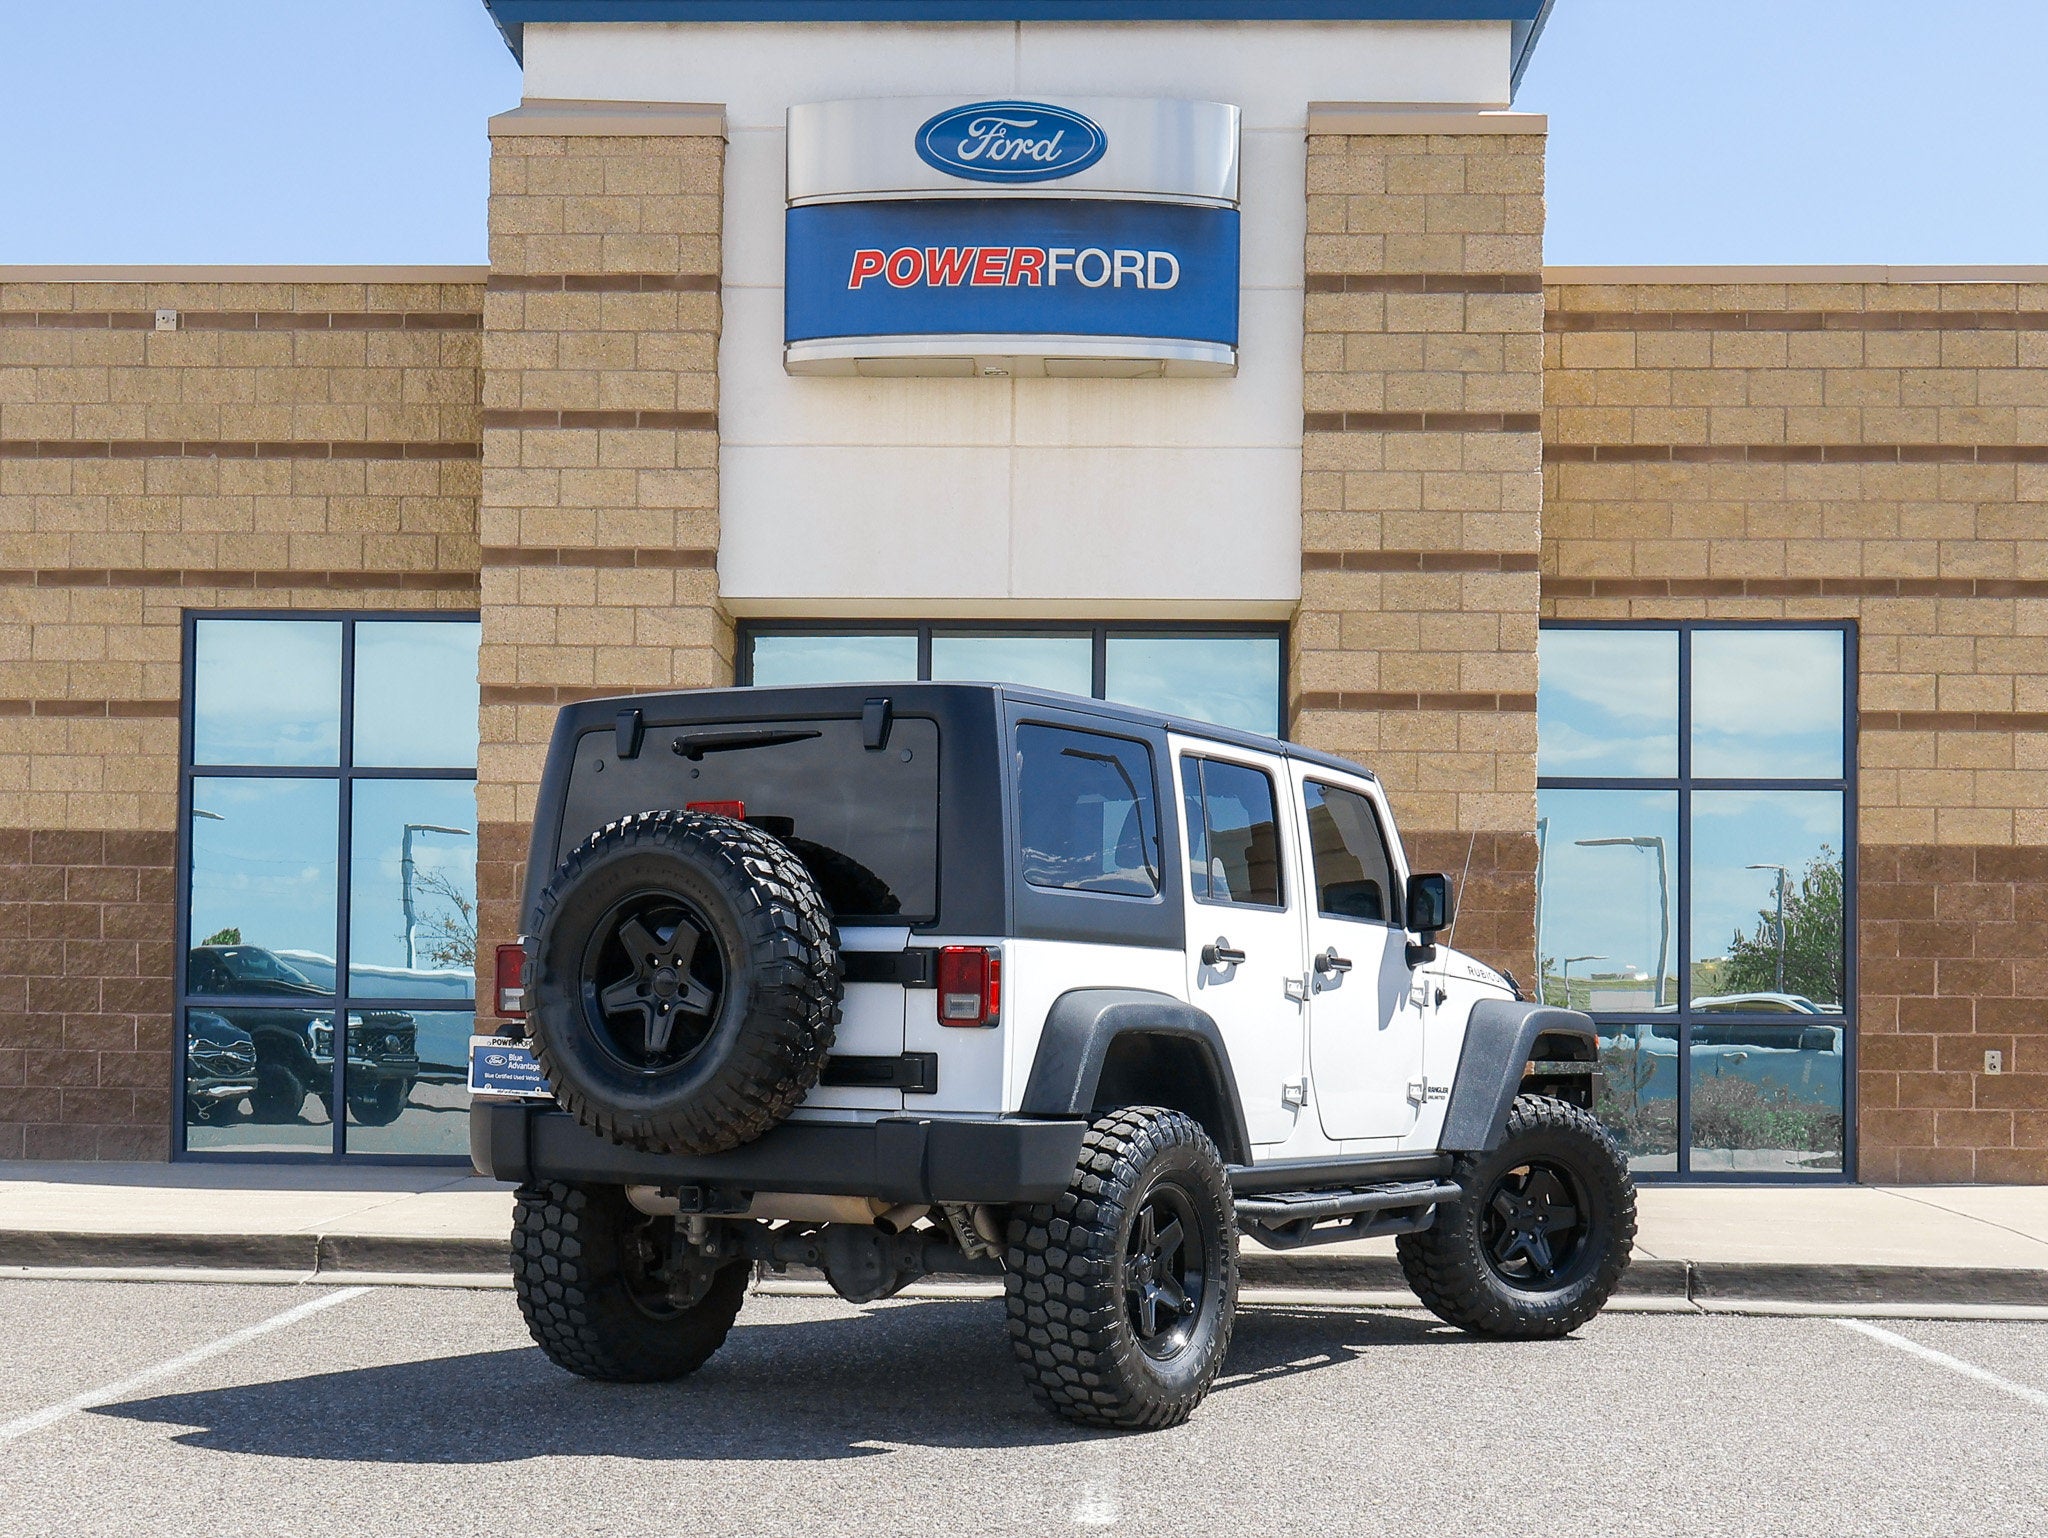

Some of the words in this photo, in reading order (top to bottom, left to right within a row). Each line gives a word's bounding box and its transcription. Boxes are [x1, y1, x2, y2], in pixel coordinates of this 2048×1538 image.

[957, 117, 1065, 163] Ford
[508, 1053, 524, 1061] Blue
[507, 1061, 540, 1072] Advantage
